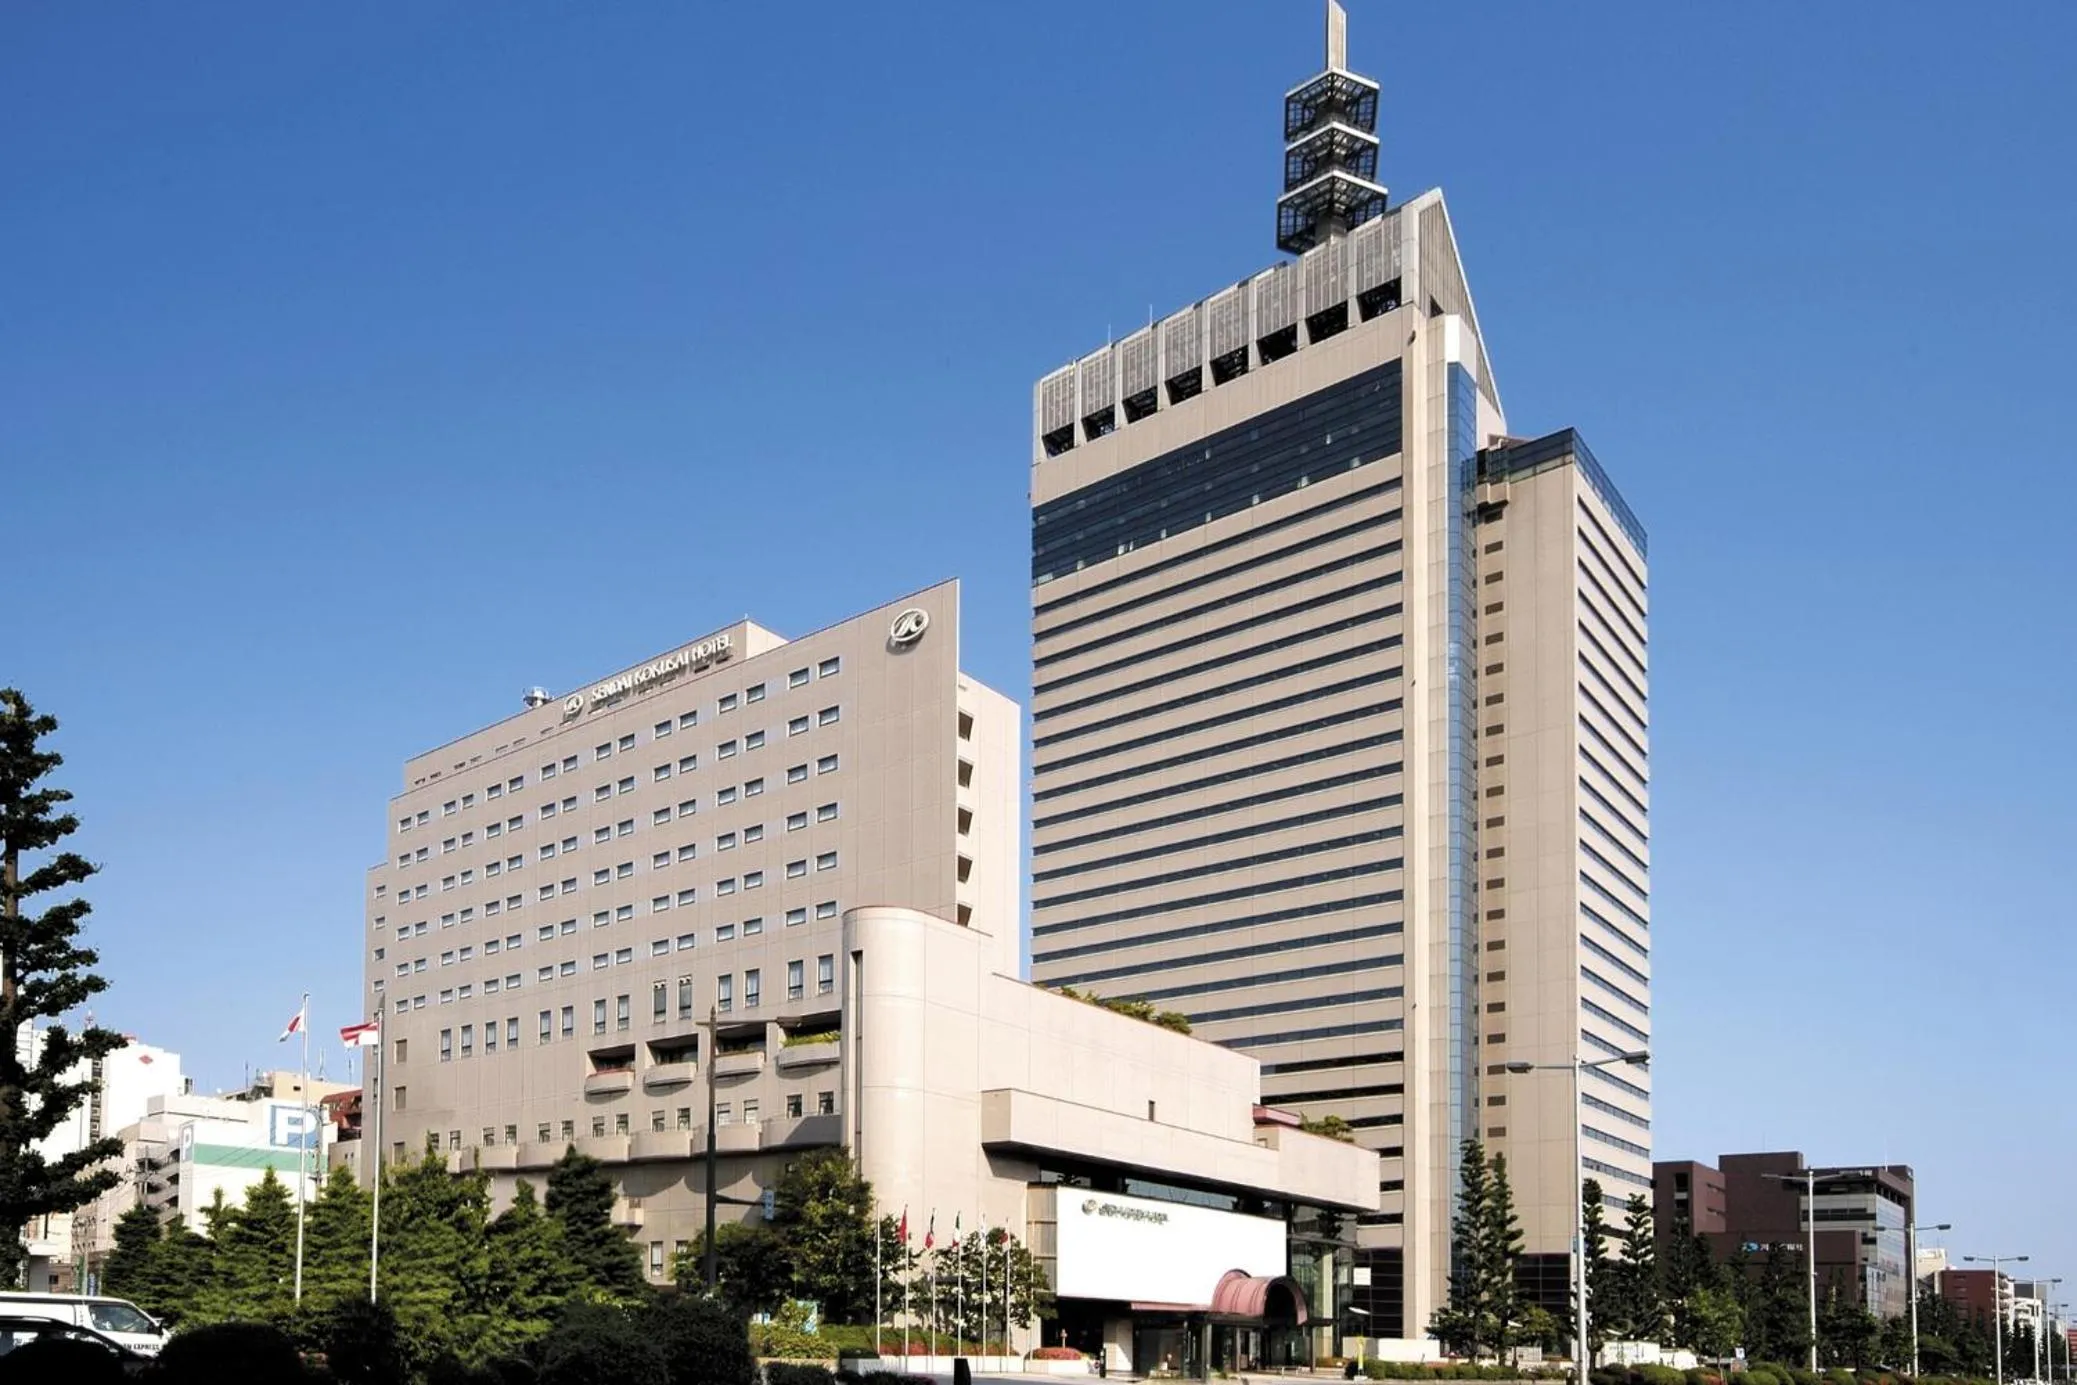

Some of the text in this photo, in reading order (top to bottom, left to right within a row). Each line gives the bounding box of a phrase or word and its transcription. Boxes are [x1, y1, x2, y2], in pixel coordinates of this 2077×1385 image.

[591, 634, 733, 702] SENDAI KOKUSAI HOTEL
[274, 1106, 317, 1144] P
